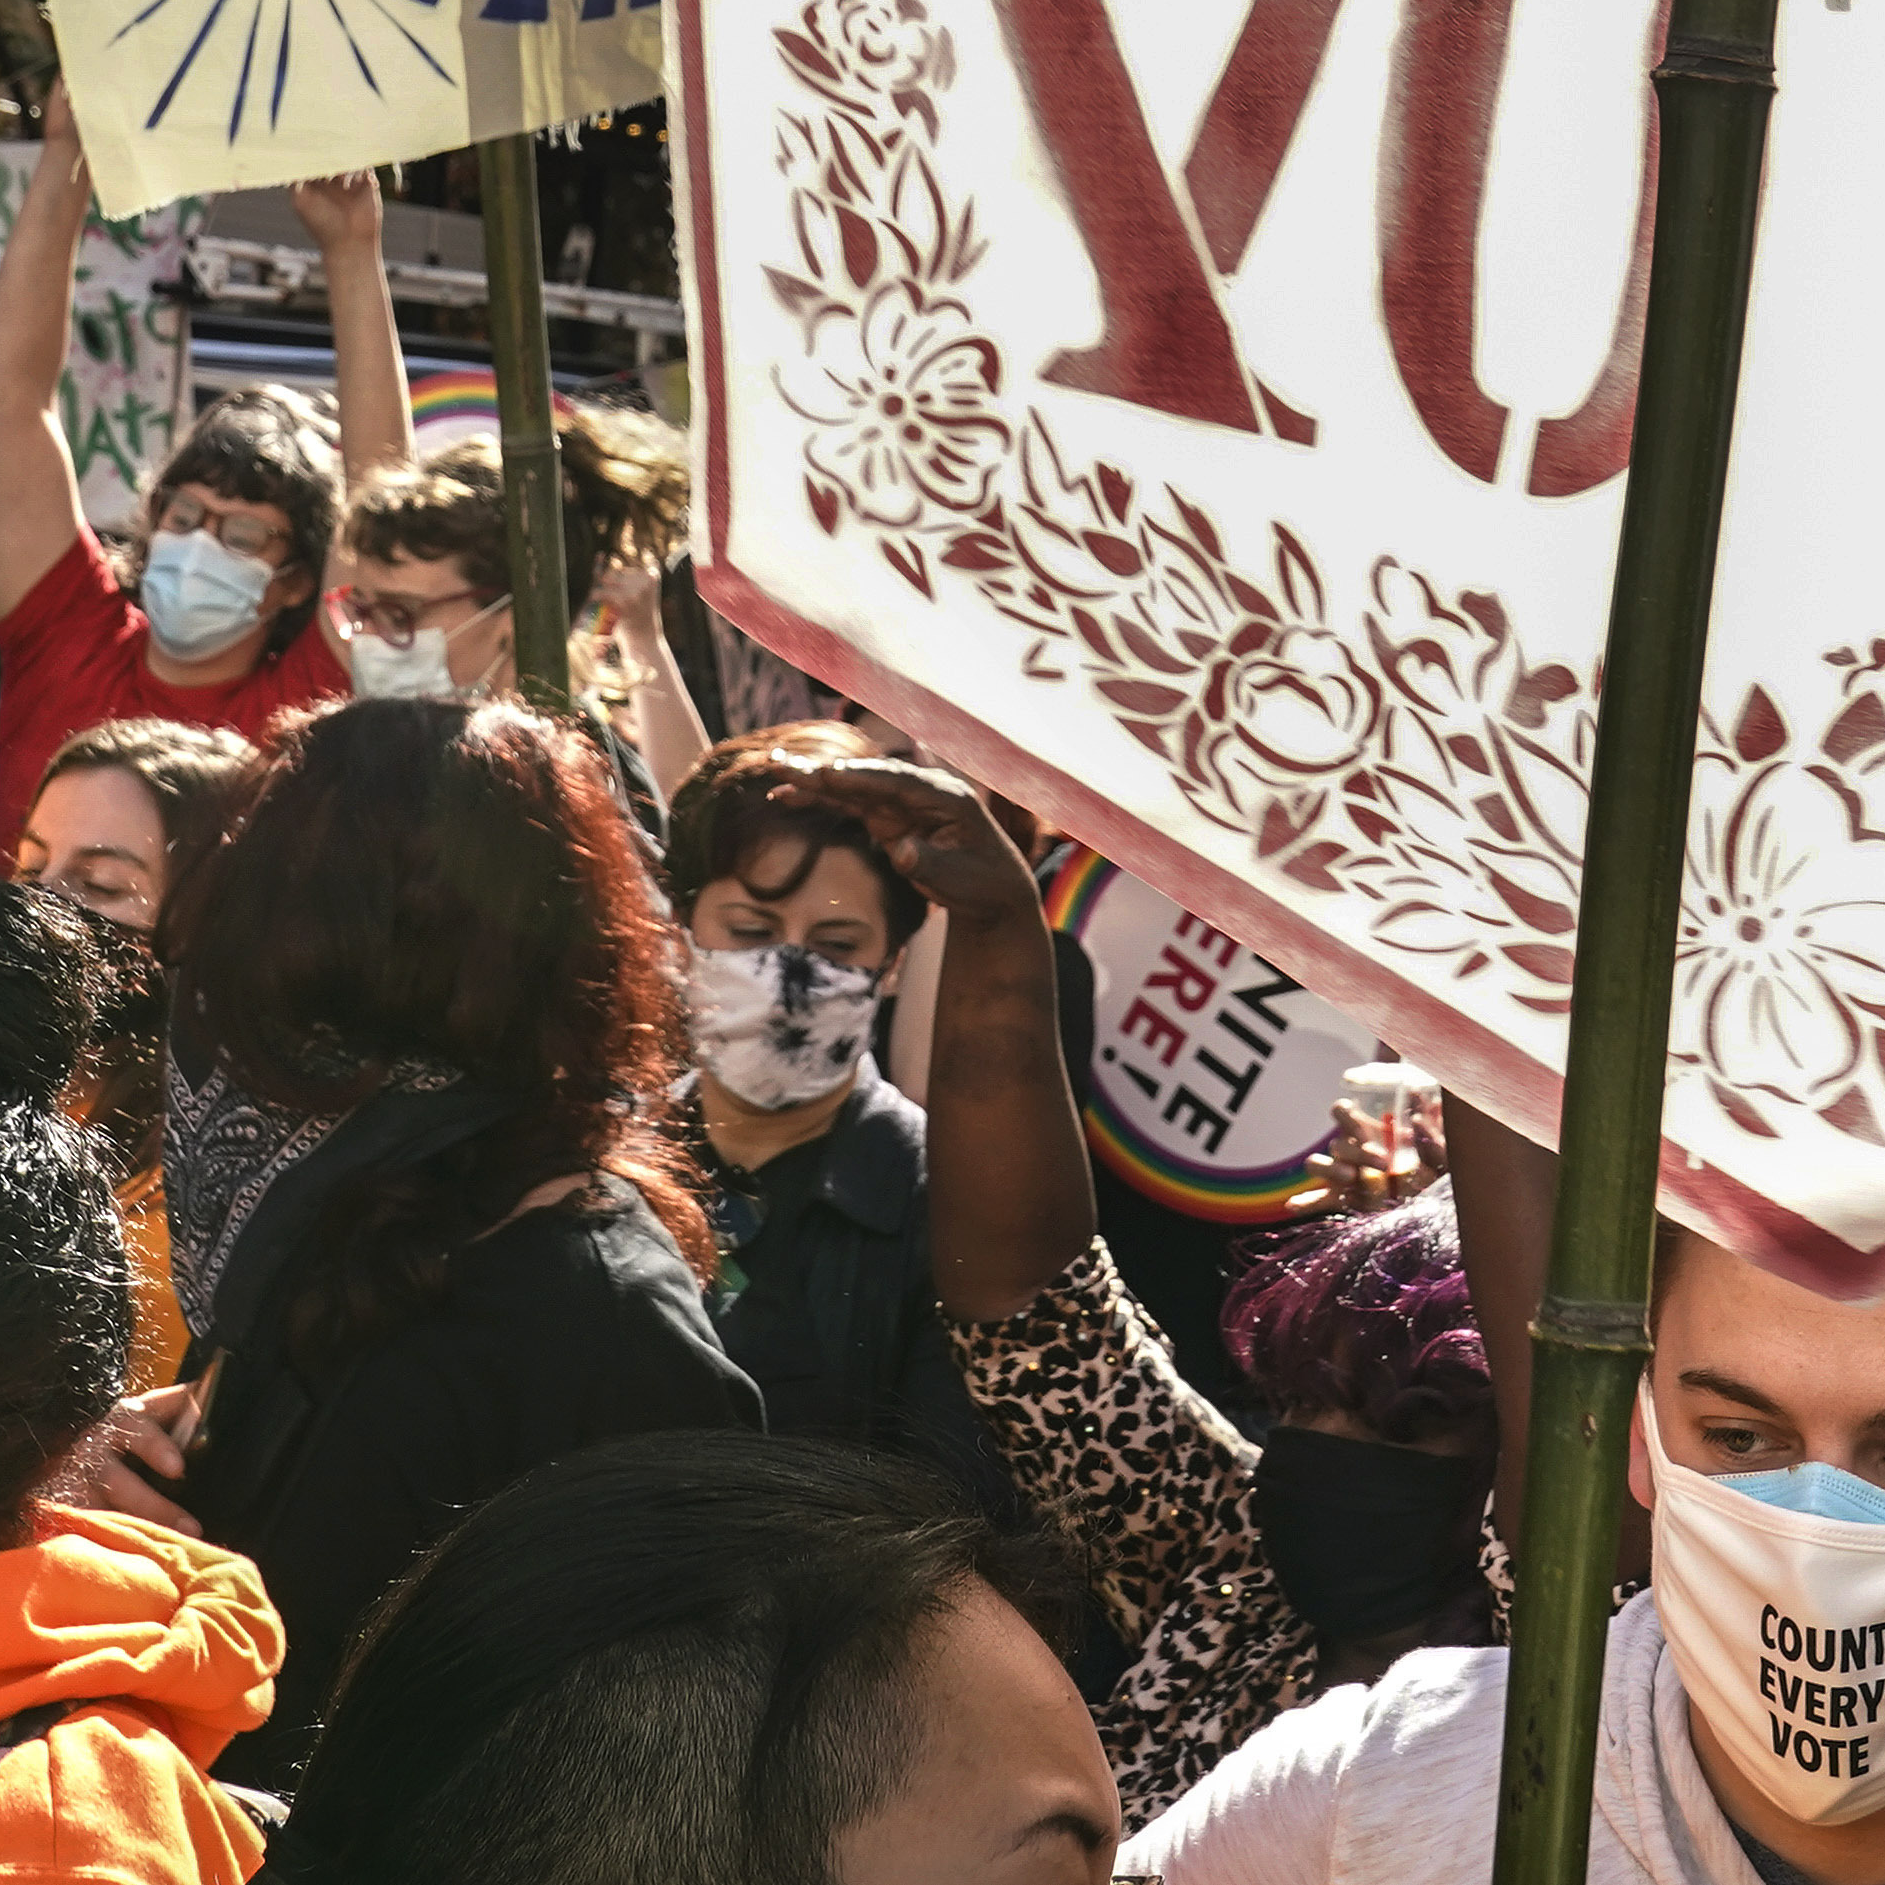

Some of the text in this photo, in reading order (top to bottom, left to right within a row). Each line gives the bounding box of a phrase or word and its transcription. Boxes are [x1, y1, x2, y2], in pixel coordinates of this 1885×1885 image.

[1101, 910, 1243, 1100] ERE!
[1163, 951, 1309, 1156] NITE
[1759, 1656, 1885, 1729] EVERY
[1768, 1710, 1870, 1779] VOTE
